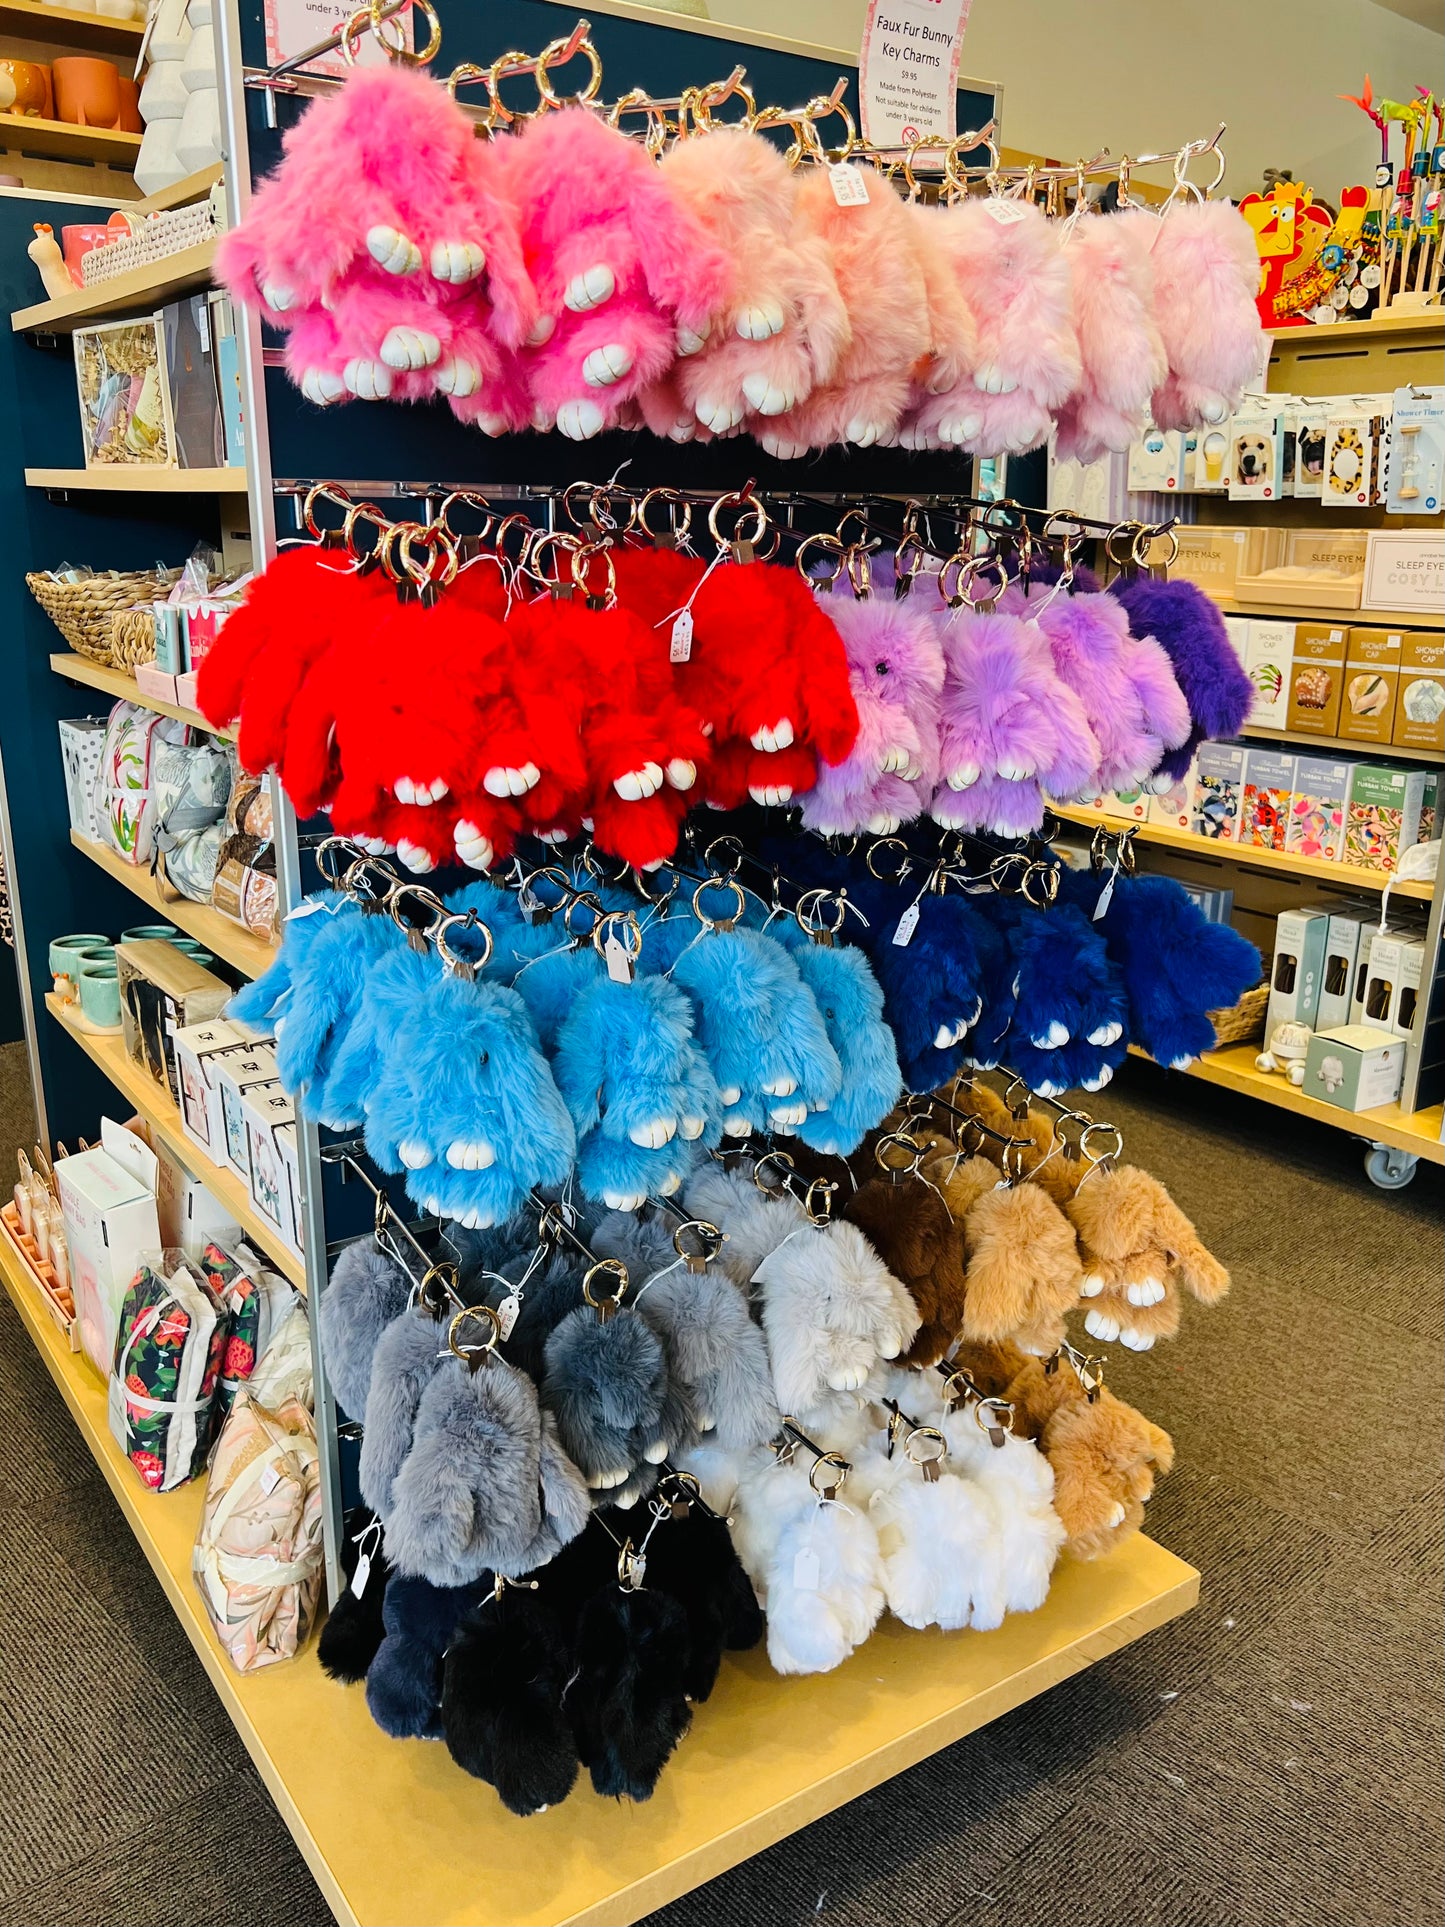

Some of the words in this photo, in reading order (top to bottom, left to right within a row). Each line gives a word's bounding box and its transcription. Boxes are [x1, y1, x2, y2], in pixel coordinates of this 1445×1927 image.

[306, 3, 332, 14] under
[334, 6, 340, 15] 3
[877, 15, 901, 33] Faux
[903, 22, 920, 37] Fur
[922, 26, 953, 48] Bunny
[882, 42, 901, 61] Key
[903, 47, 940, 67] Charms
[901, 70, 918, 81] $9.95
[880, 82, 896, 92] Made
[897, 85, 911, 95] from
[912, 88, 938, 100] Polyester
[875, 95, 886, 104] Not
[887, 98, 909, 109] suitable
[910, 103, 918, 111] for
[919, 104, 941, 115] children
[885, 111, 902, 121] under
[903, 113, 908, 121] 3
[908, 116, 923, 125] years
[924, 117, 933, 126] old
[1423, 408, 1444, 416] Timer
[1312, 554, 1336, 562] SLEEP
[1338, 555, 1353, 563] EYE
[1396, 561, 1424, 570] SLEEP
[1426, 562, 1444, 571] EYE
[1387, 573, 1429, 586] COSY
[1415, 646, 1444, 655] SHOWER
[1421, 655, 1436, 663] CAP
[1301, 773, 1322, 781] TURBAN
[1323, 776, 1343, 784] TOWEL
[1357, 781, 1379, 790] TURBAN
[1380, 785, 1401, 794] TOWEL
